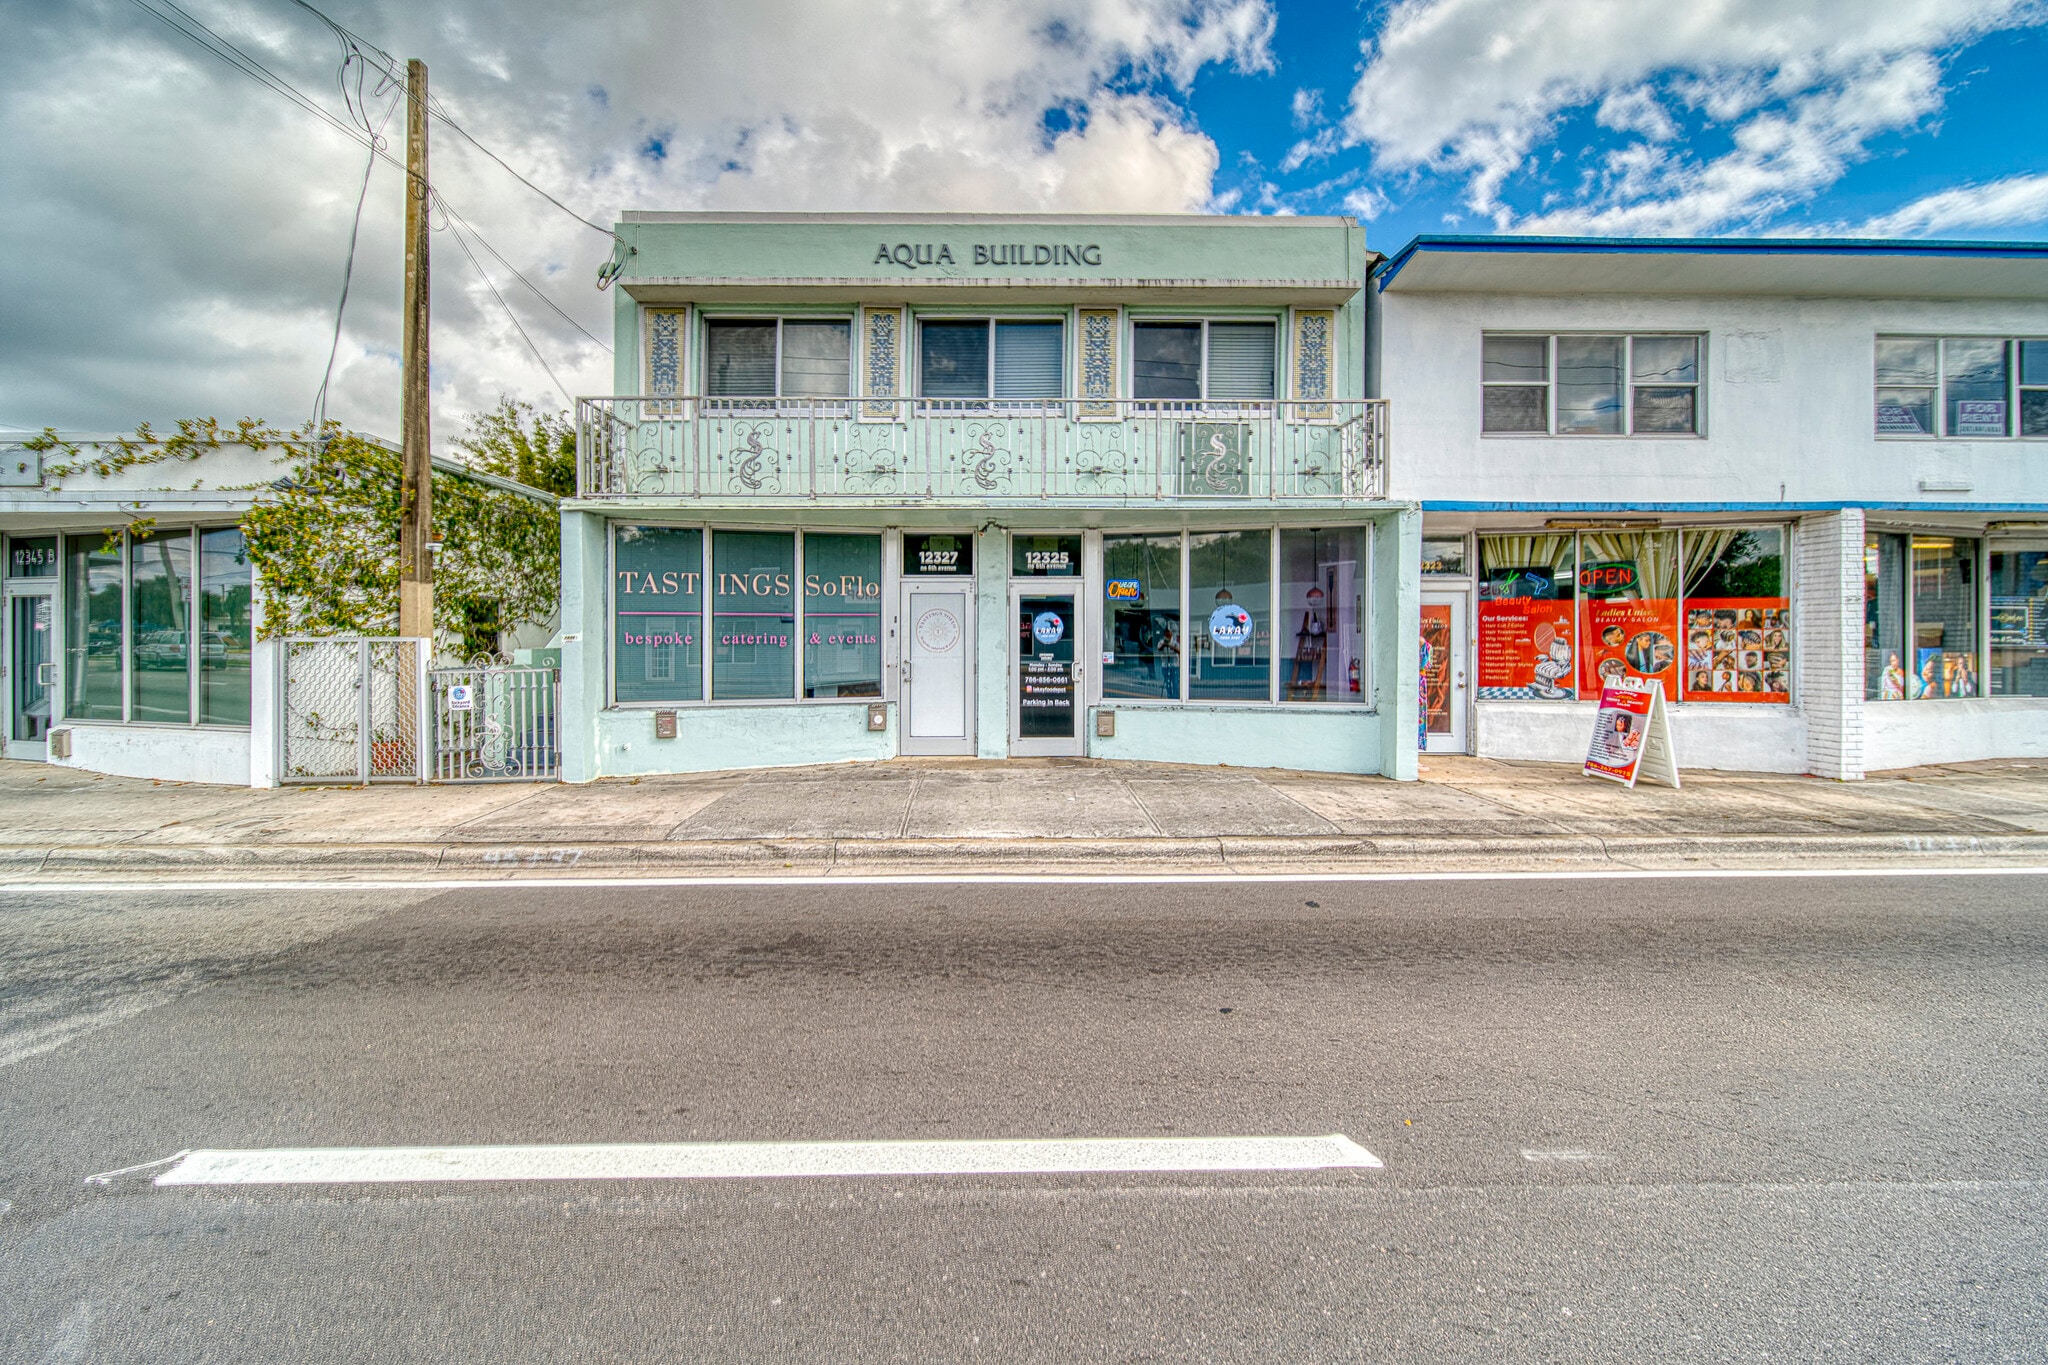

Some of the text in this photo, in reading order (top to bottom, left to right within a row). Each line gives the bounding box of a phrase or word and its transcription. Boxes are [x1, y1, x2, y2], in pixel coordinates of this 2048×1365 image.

[874, 243, 1102, 269] AQUA BUILDING
[1878, 406, 1904, 415] OR
[1965, 403, 1997, 413] FOR
[1961, 413, 2002, 423] RENT
[15, 549, 55, 565] 12345 B
[919, 551, 959, 565] 12327
[1025, 552, 1069, 564] 12325
[1579, 568, 1632, 586] OPEN
[805, 575, 879, 597] SoFlo
[1108, 581, 1137, 598] Open
[1495, 596, 1532, 606] Beauty
[1523, 604, 1553, 614] Salon
[1627, 608, 1654, 616] Unise
[1035, 626, 1063, 635] LAKAY
[1212, 625, 1250, 635] LAKAY
[625, 632, 693, 648] bespoke
[722, 632, 788, 647] catering
[809, 632, 877, 645] & events
[1022, 699, 1047, 707] Parking
